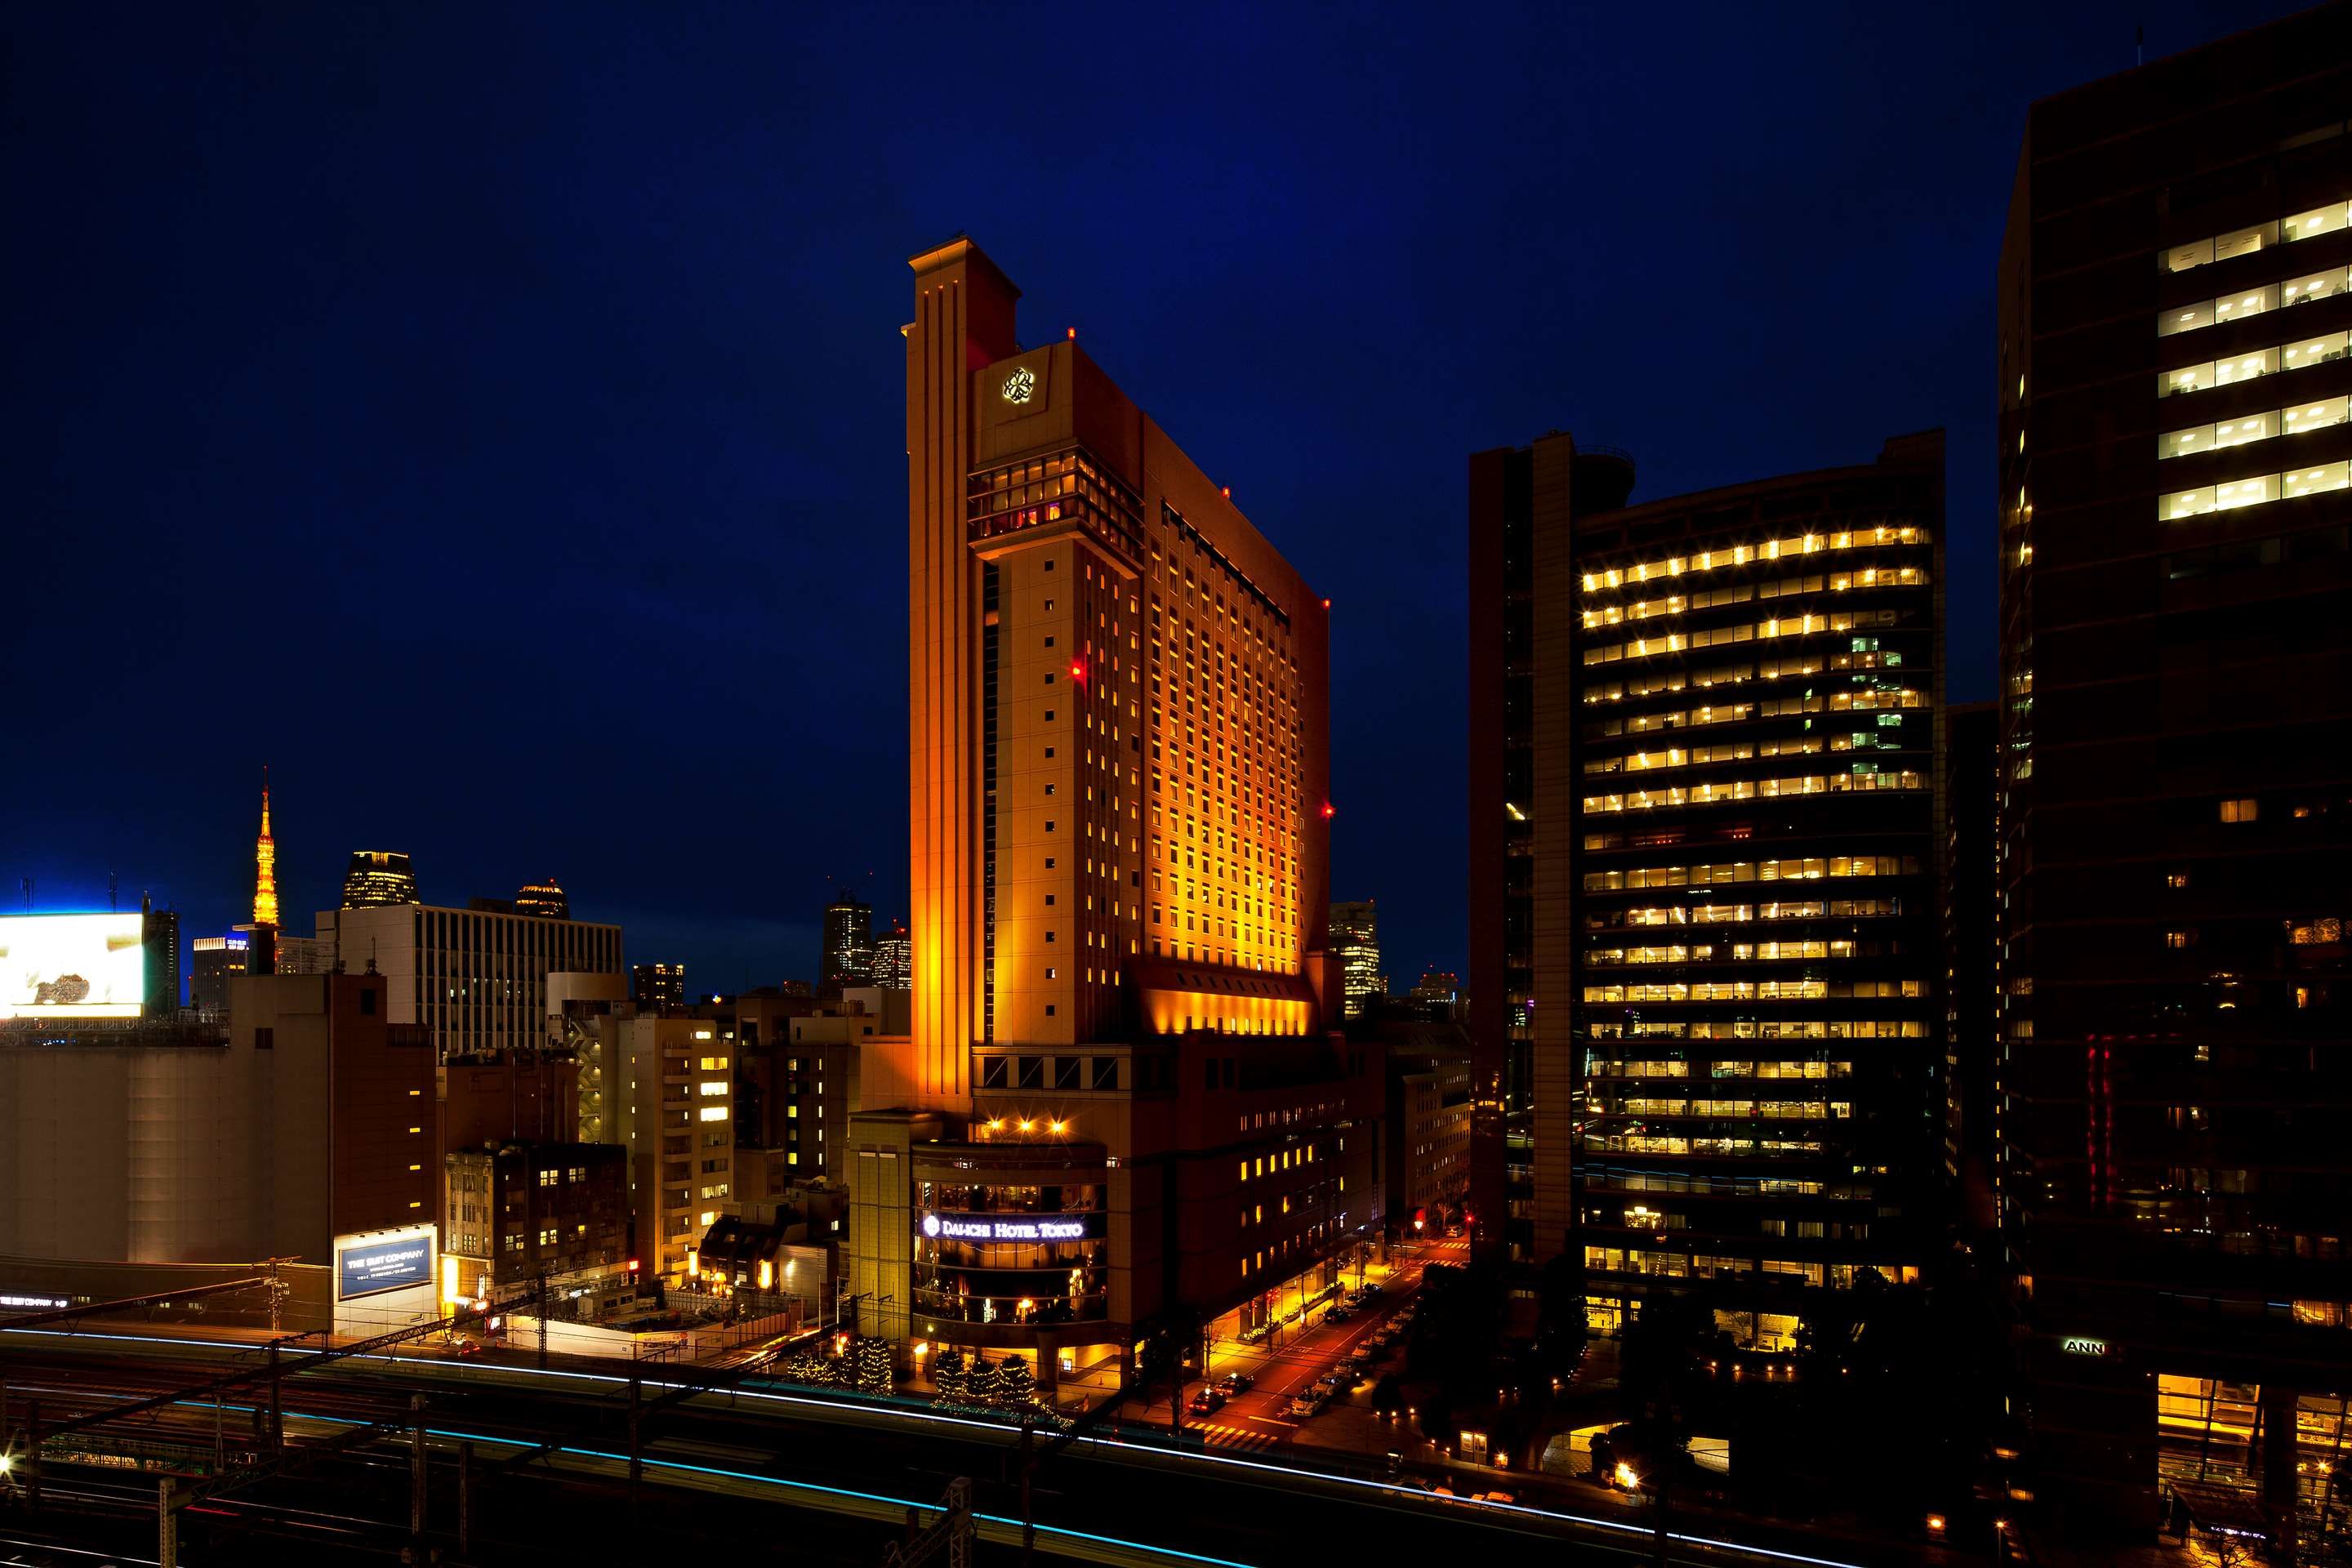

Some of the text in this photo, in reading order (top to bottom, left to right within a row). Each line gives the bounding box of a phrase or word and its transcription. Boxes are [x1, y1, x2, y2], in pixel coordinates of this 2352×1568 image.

[995, 1223, 1038, 1238] HOTEL
[1038, 1223, 1083, 1237] TOKYO
[385, 1250, 424, 1263] COMPANY
